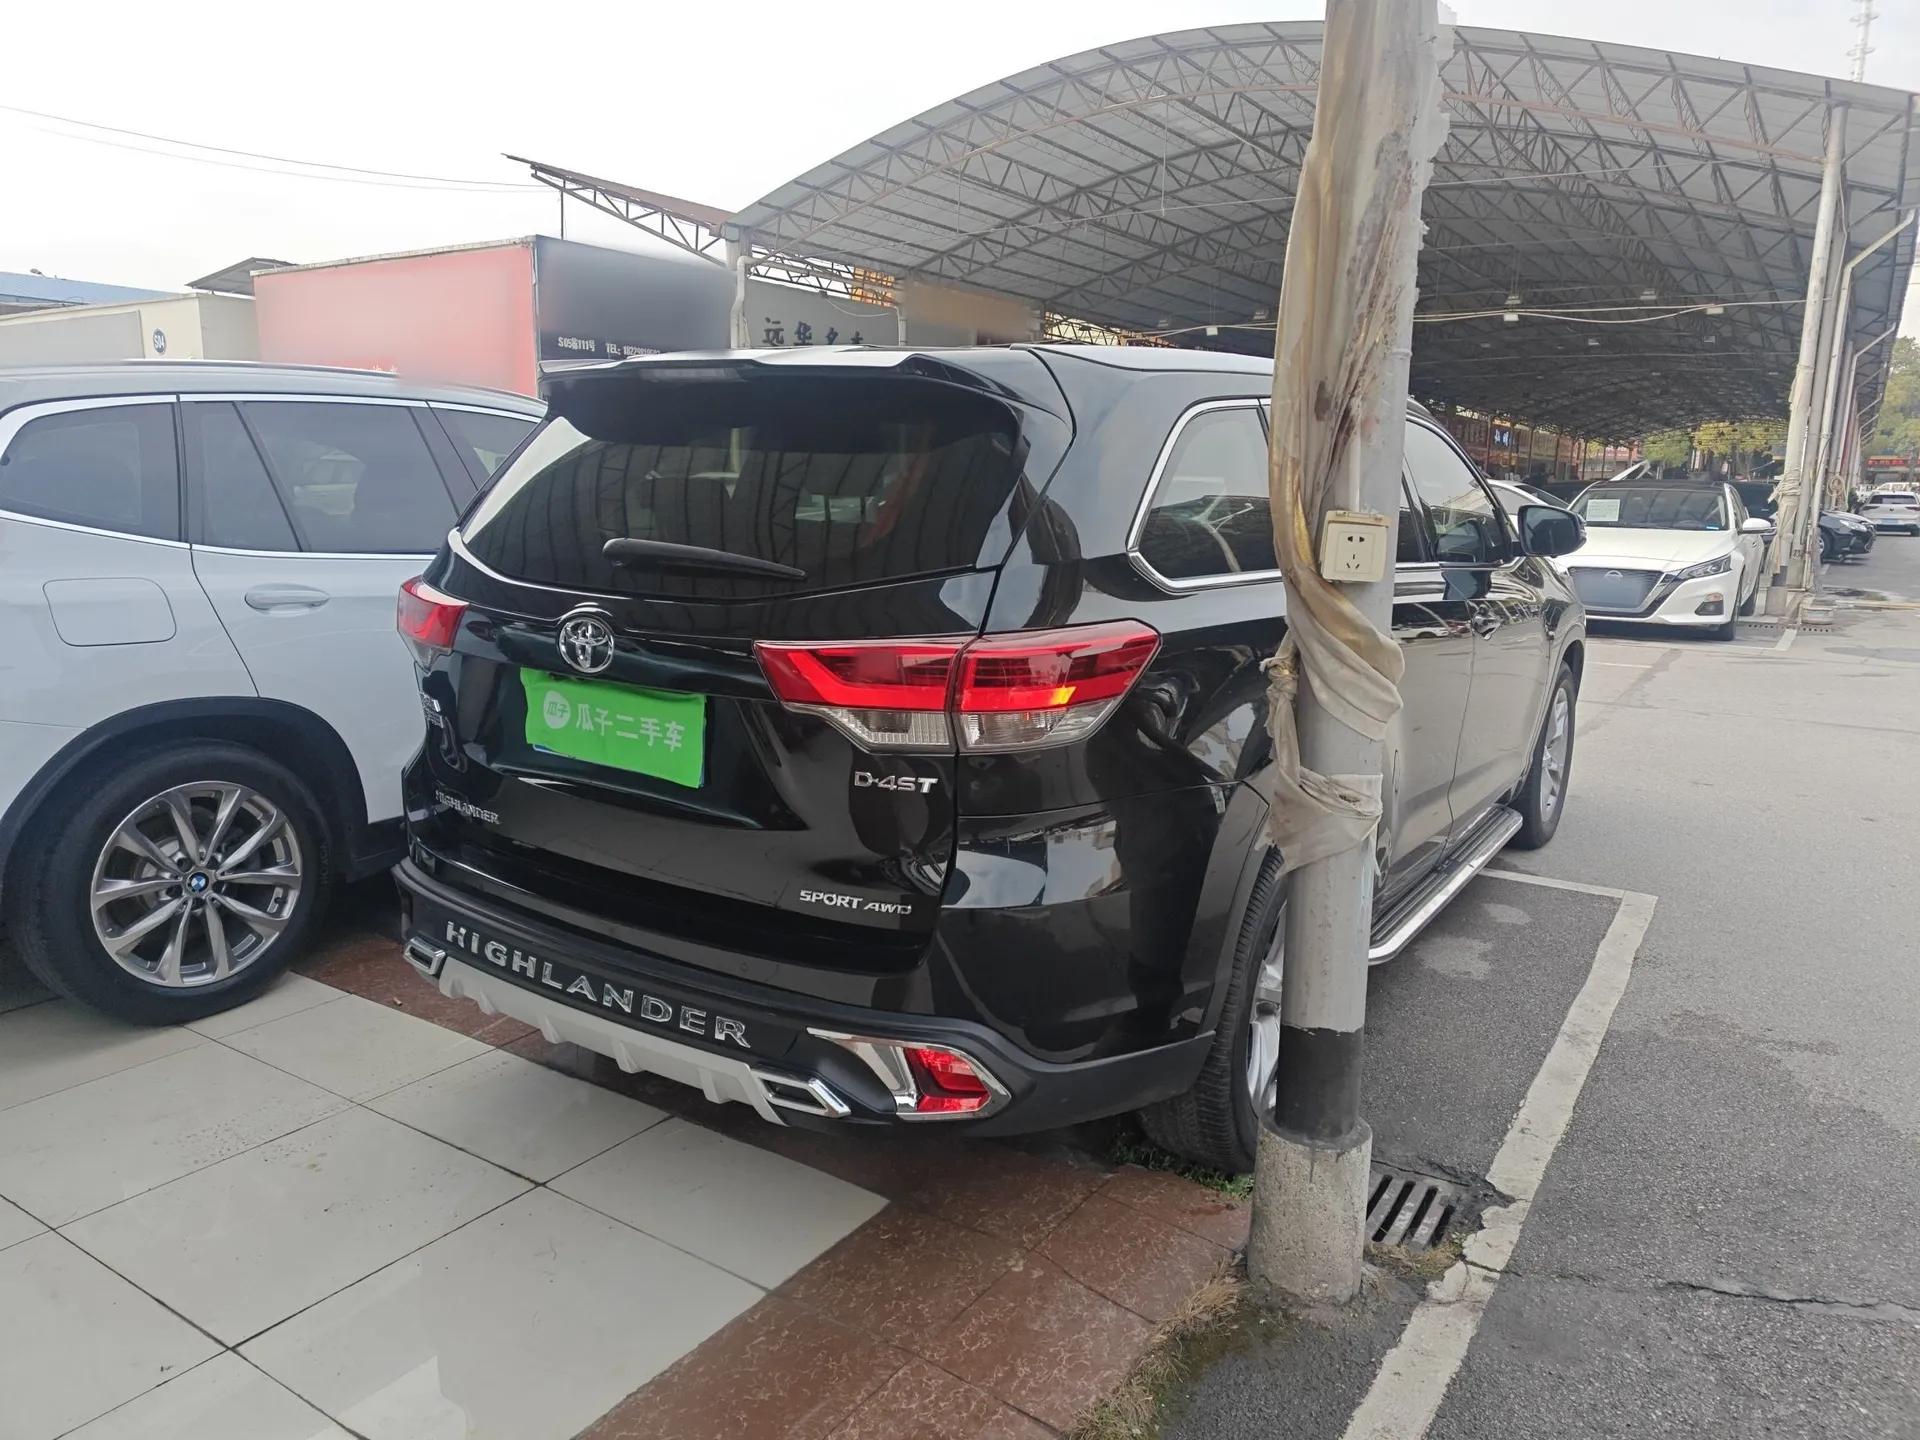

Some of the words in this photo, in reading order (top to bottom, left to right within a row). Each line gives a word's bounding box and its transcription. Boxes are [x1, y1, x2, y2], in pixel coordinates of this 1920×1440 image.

[576, 703, 685, 752] 瓜子二手车
[800, 889, 863, 909] SPORT
[864, 902, 912, 915] AWD
[446, 921, 751, 1049] HIGHLANDER
